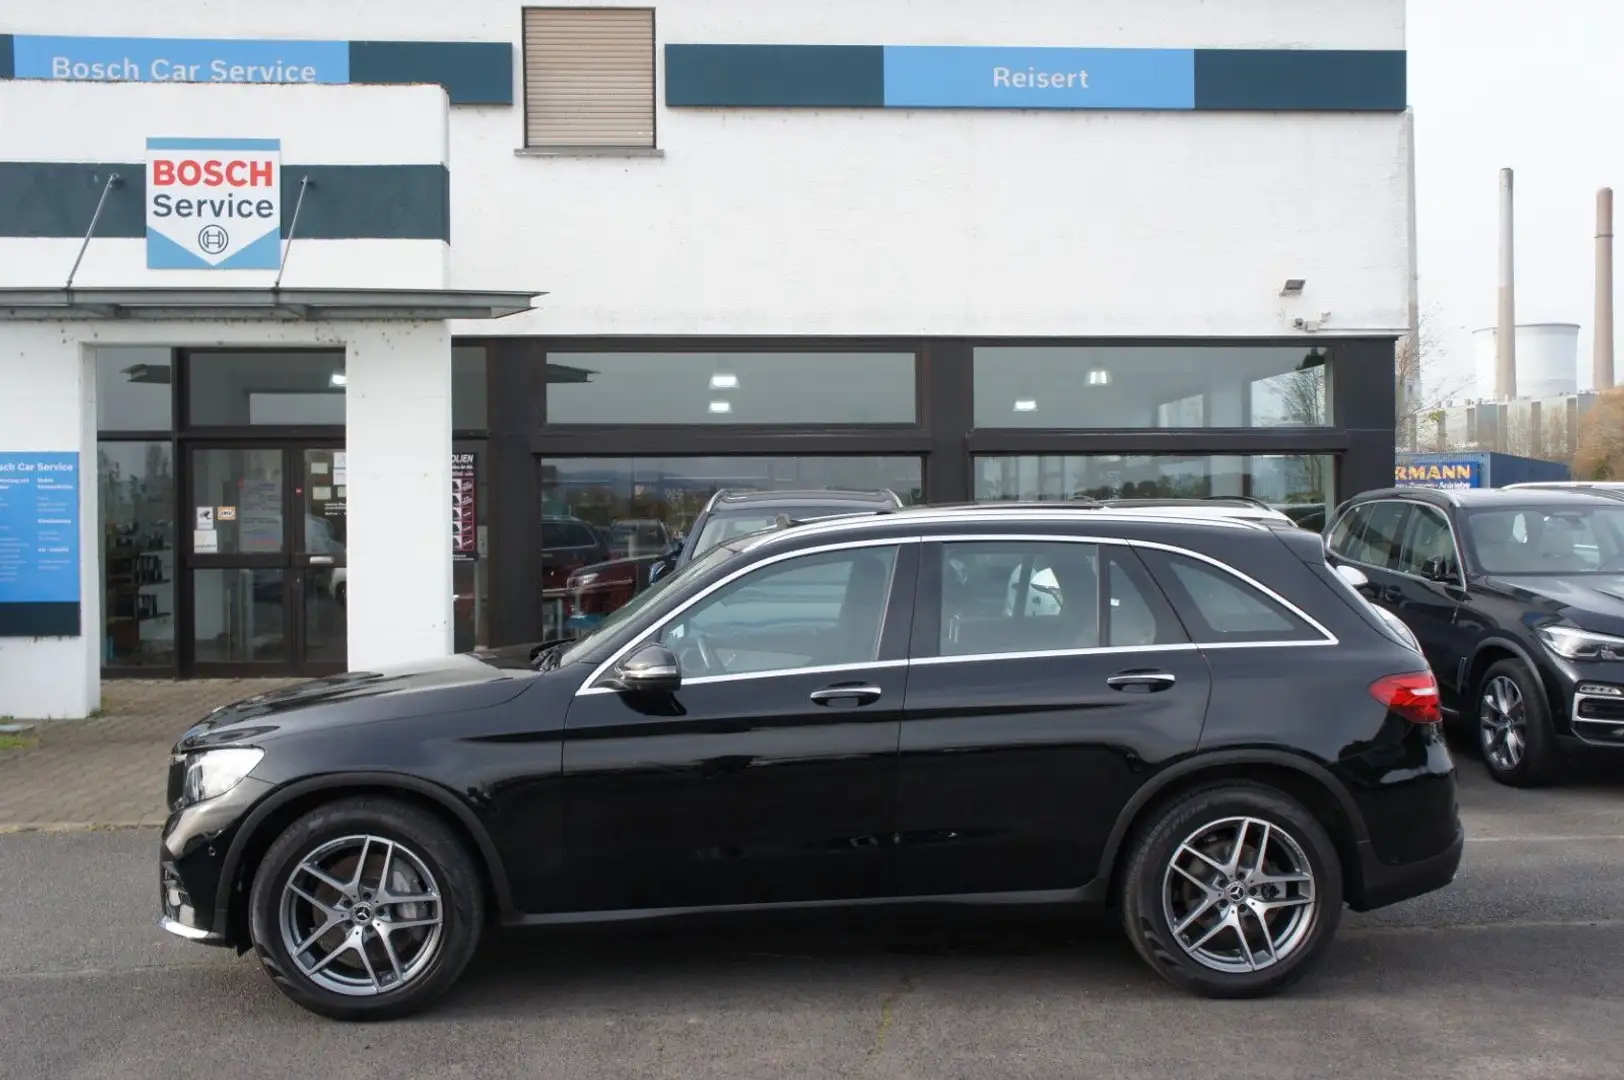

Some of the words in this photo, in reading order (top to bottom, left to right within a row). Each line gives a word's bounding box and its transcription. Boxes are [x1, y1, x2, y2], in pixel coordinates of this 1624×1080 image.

[52, 56, 139, 80] Bosch
[151, 58, 200, 81] Car
[211, 59, 317, 82] Service
[993, 66, 1089, 88] Reisert
[153, 160, 272, 187] BOSCH
[153, 193, 274, 218] Service
[17, 462, 35, 471] Car
[37, 462, 74, 471] Service
